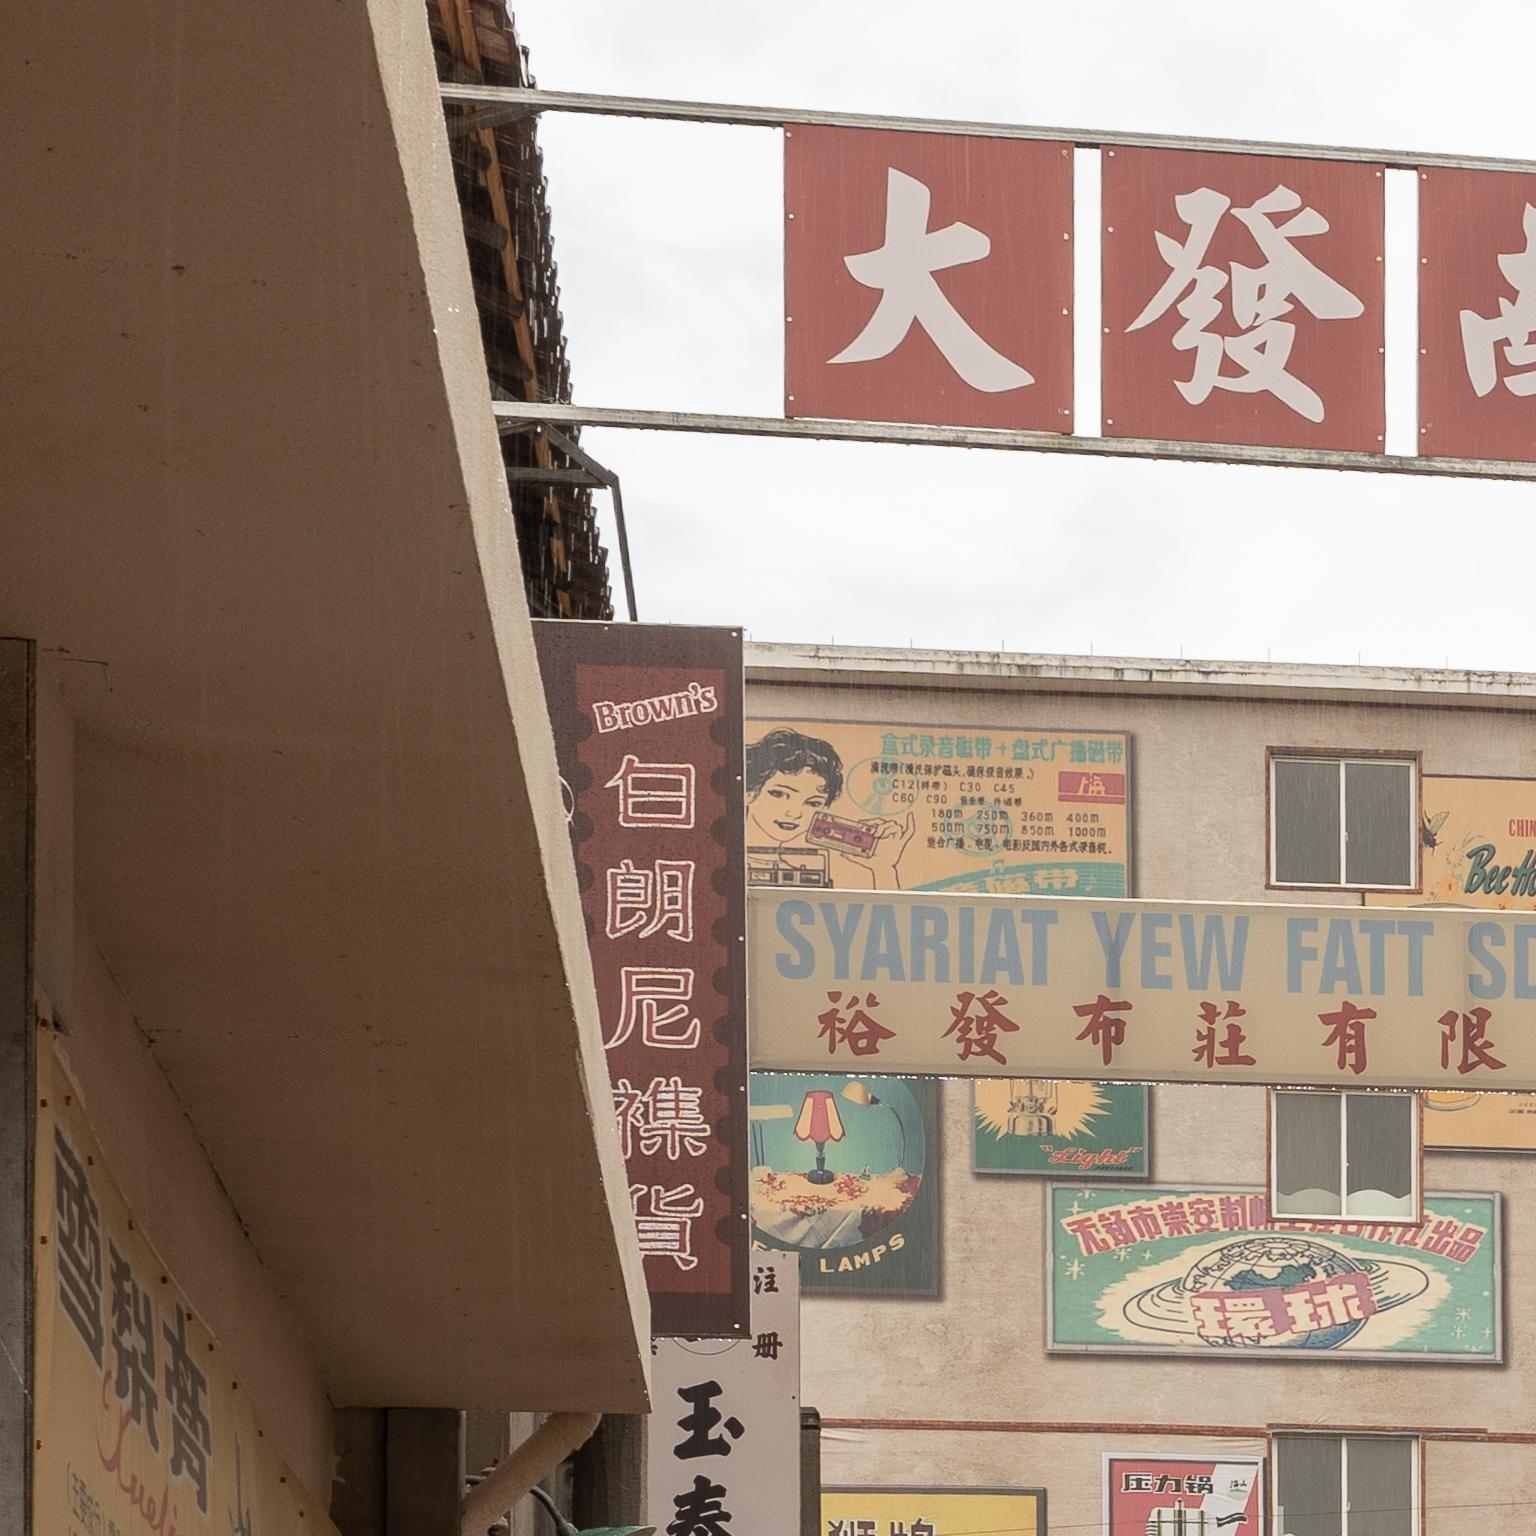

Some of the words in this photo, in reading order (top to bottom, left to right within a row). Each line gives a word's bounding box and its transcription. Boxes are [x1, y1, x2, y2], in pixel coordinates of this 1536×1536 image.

[593, 682, 718, 736] Brown's
[926, 793, 948, 805] C90
[960, 782, 981, 793] C30
[994, 782, 1015, 794] C45
[931, 808, 963, 819] 180m
[976, 809, 1008, 821] 250m
[1021, 811, 1053, 822] 360m
[1066, 813, 1099, 824] 400m
[931, 822, 964, 833] 500m
[976, 823, 1009, 834] 750m
[1068, 826, 1107, 838] 1000m
[1464, 843, 1512, 896] Bee
[774, 901, 1060, 987] SYARIAT
[1091, 910, 1251, 992] YEW
[1286, 917, 1435, 997] FATT
[819, 1232, 906, 1274] LAMPS
[1122, 1473, 1214, 1495] 压力锅
